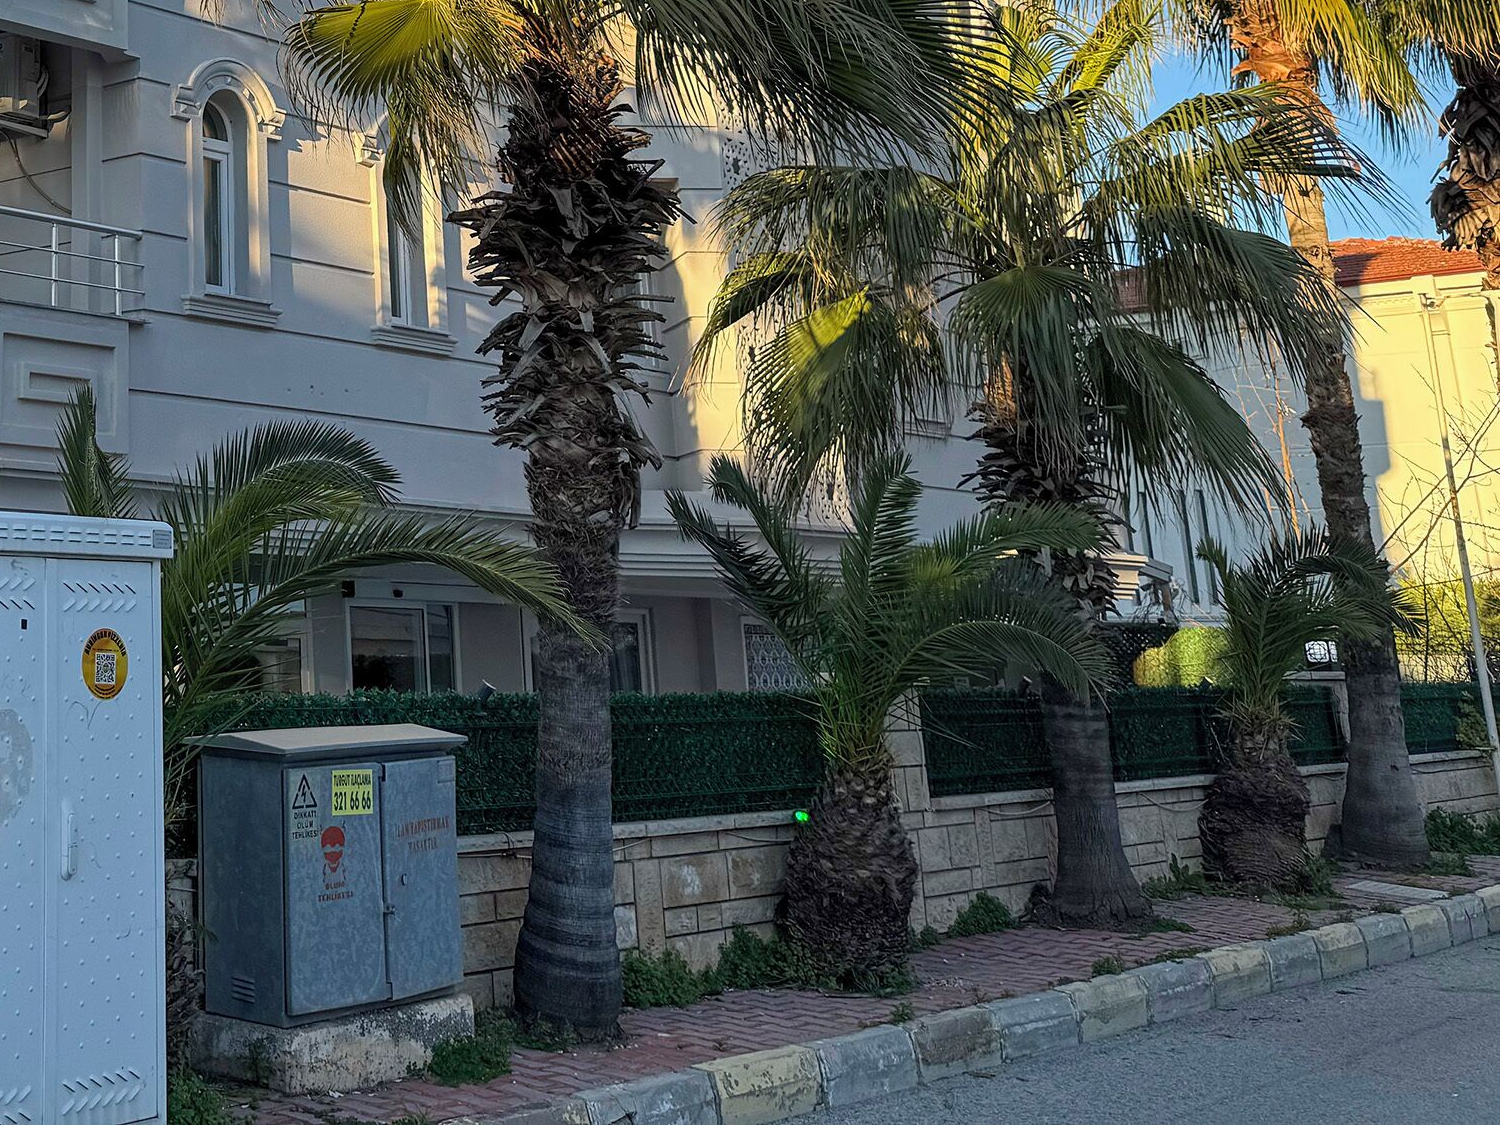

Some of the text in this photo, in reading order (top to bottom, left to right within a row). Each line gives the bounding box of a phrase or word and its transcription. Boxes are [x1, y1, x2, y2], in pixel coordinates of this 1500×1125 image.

[333, 790, 372, 811] 321 66 66
